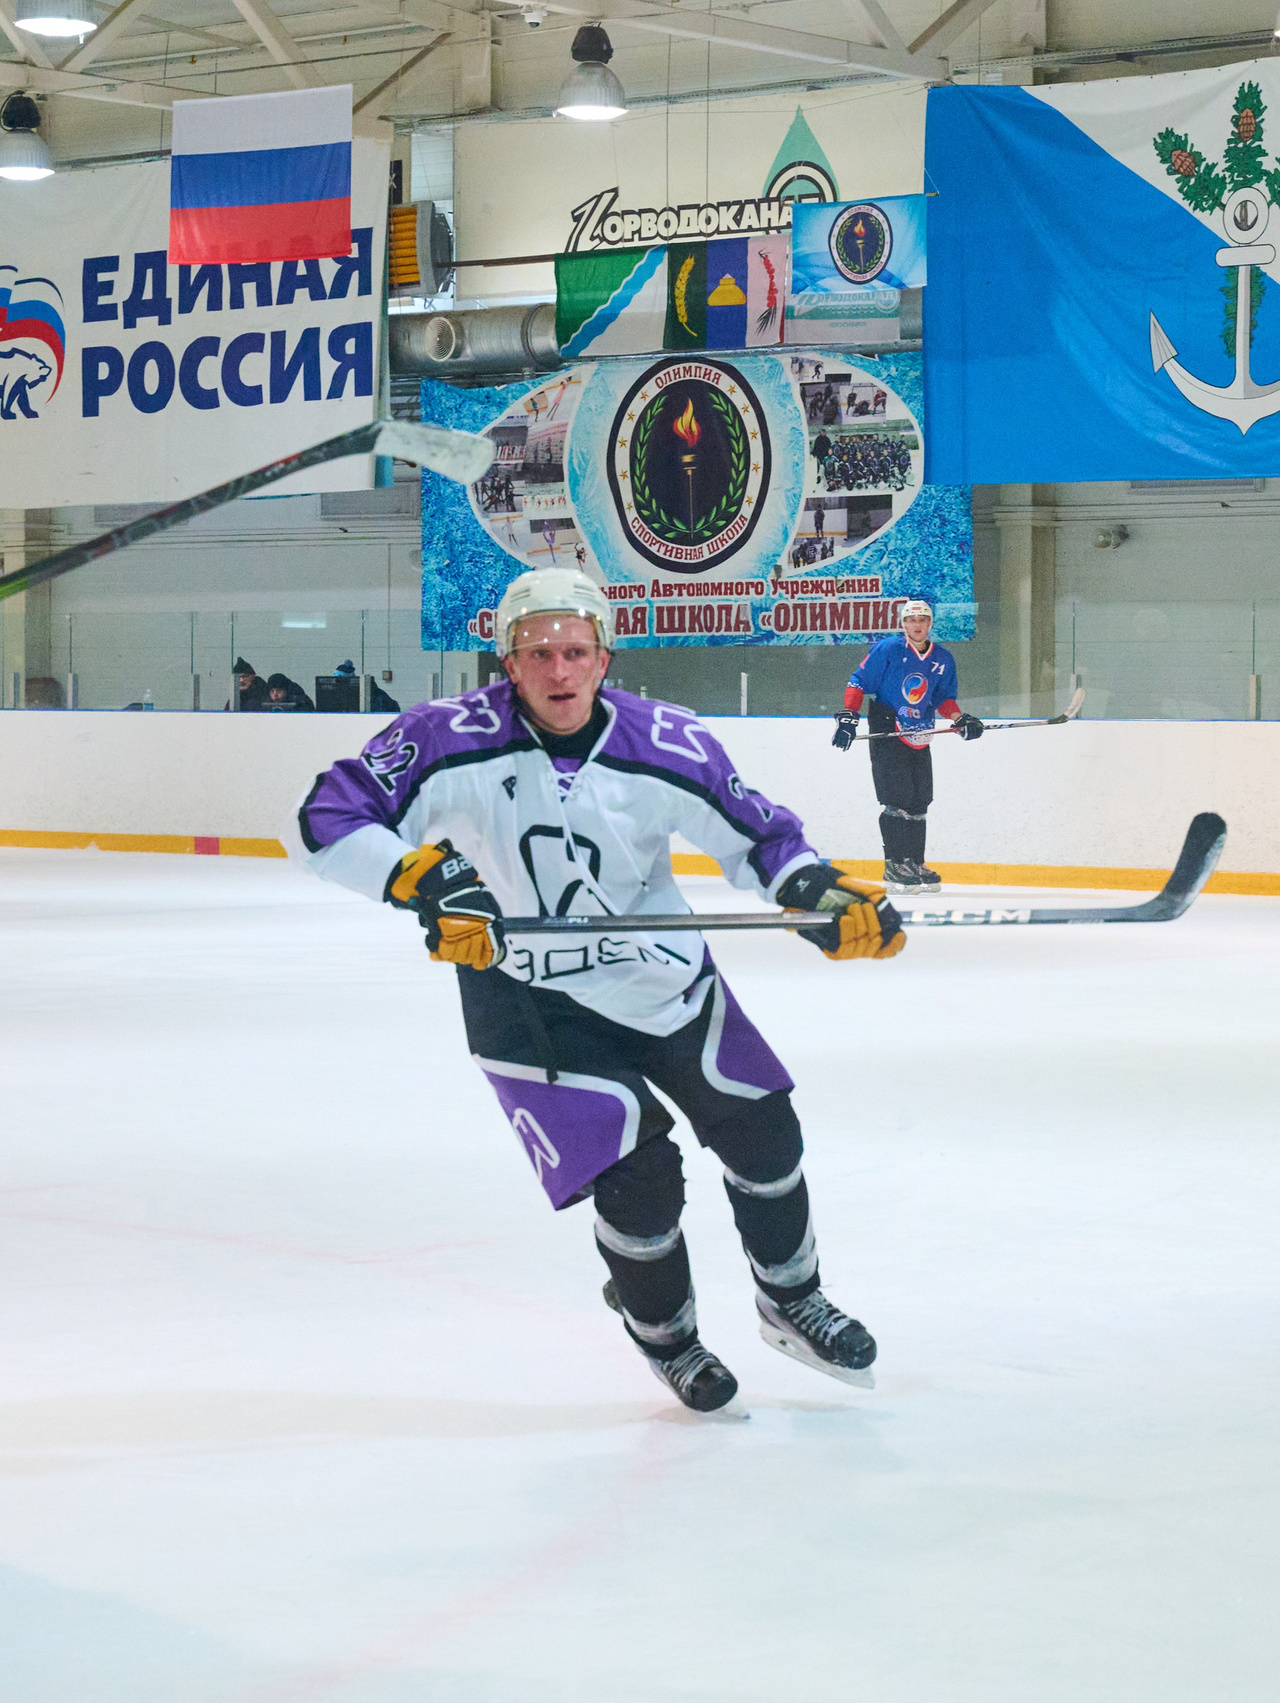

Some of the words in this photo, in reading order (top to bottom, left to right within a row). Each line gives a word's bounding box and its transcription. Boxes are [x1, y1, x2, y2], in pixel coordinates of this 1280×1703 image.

[82, 227, 374, 329] ЕДИНАЯ
[82, 321, 374, 418] РОССИЯ
[655, 365, 723, 390] ОЛИМПИЯ
[630, 516, 704, 560] СПОРТИВНАЯ
[706, 513, 749, 554] ШКОЛА
[655, 604, 751, 635] ШКОЛА
[931, 661, 946, 676] 71
[840, 718, 860, 727] CC
